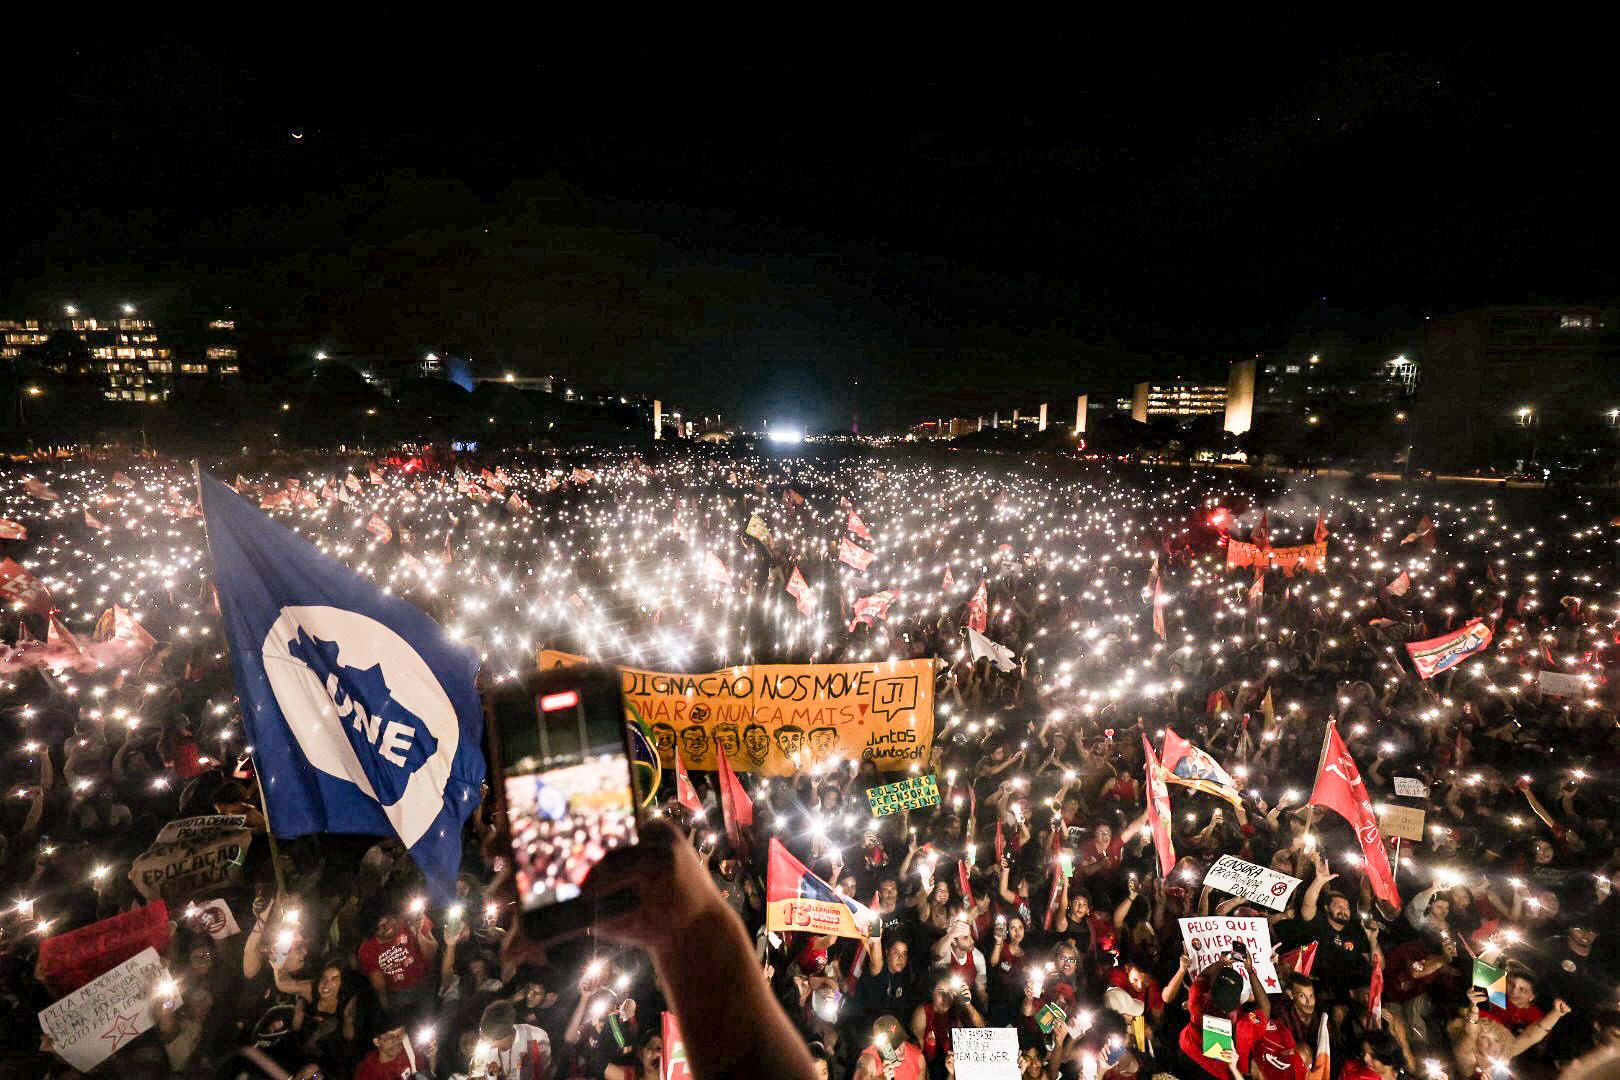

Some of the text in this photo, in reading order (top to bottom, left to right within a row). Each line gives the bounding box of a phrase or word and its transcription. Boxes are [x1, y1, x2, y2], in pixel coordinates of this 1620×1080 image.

[760, 673, 811, 701] NOS
[813, 671, 874, 700] MOVE
[326, 672, 416, 768] UNE
[716, 704, 784, 725] NUNCA
[790, 703, 870, 727] MAIS!
[870, 775, 933, 798] BOLSONARO
[870, 788, 924, 807] DEFENSOR
[1218, 857, 1264, 878] CENSURA
[1187, 920, 1258, 933] PELOS QUE
[956, 1051, 971, 1061] TEM
